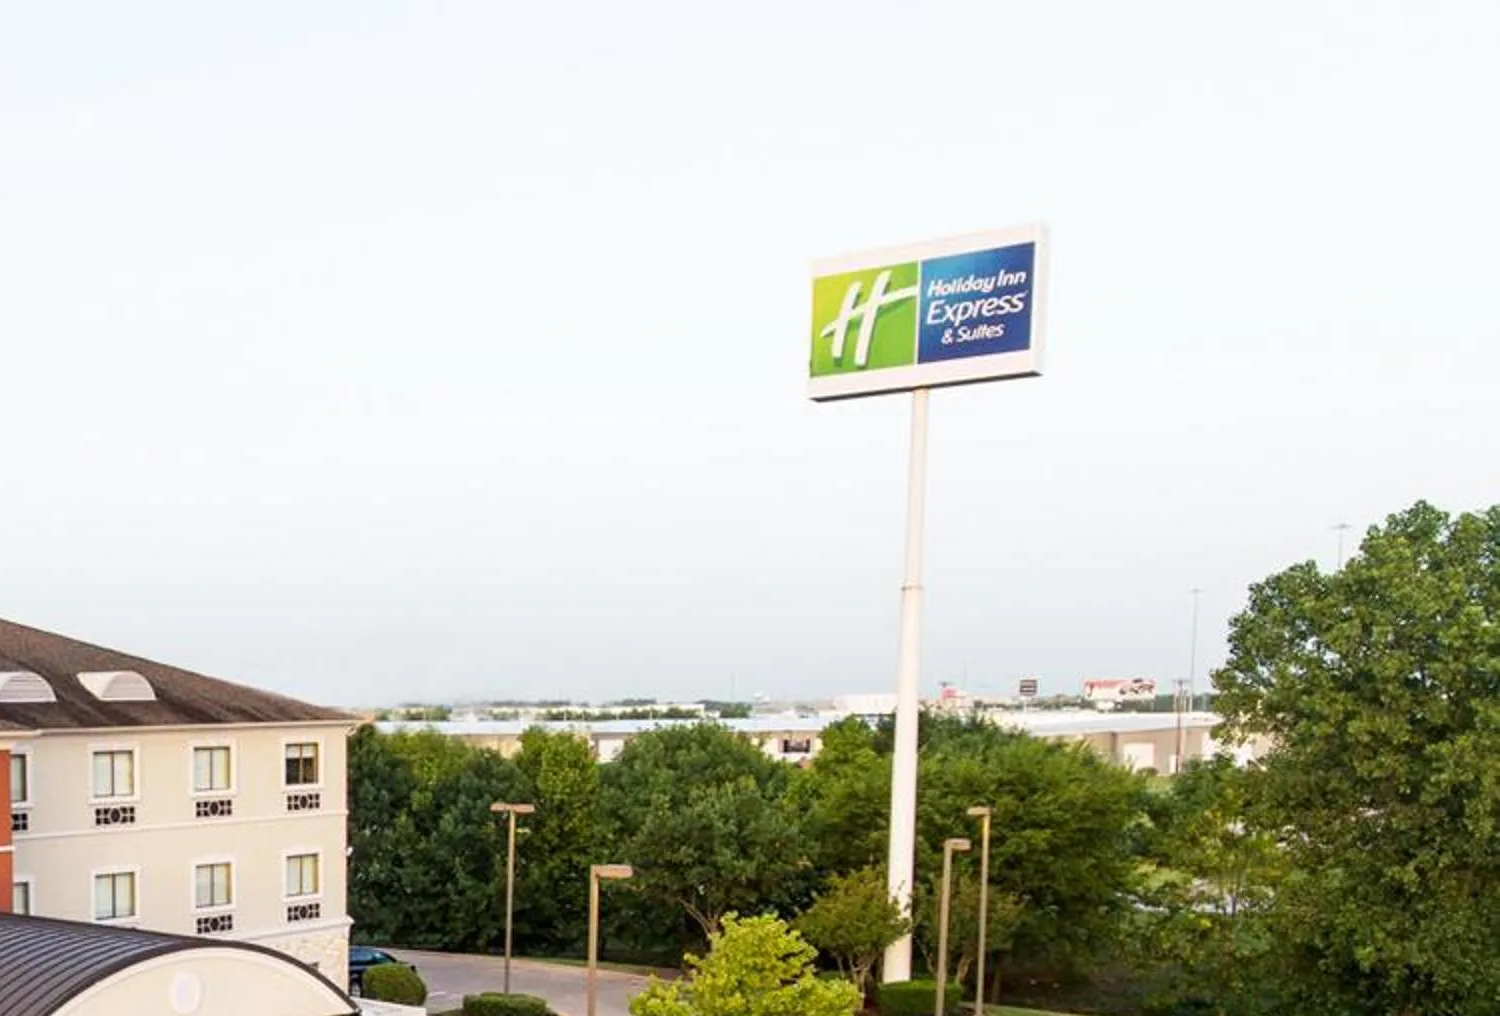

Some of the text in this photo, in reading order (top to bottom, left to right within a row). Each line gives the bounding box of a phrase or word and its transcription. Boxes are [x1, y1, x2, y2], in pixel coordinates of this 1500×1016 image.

[927, 270, 1026, 297] Holiday Inn
[926, 293, 1024, 327] Express
[941, 324, 1004, 344] & Suites
